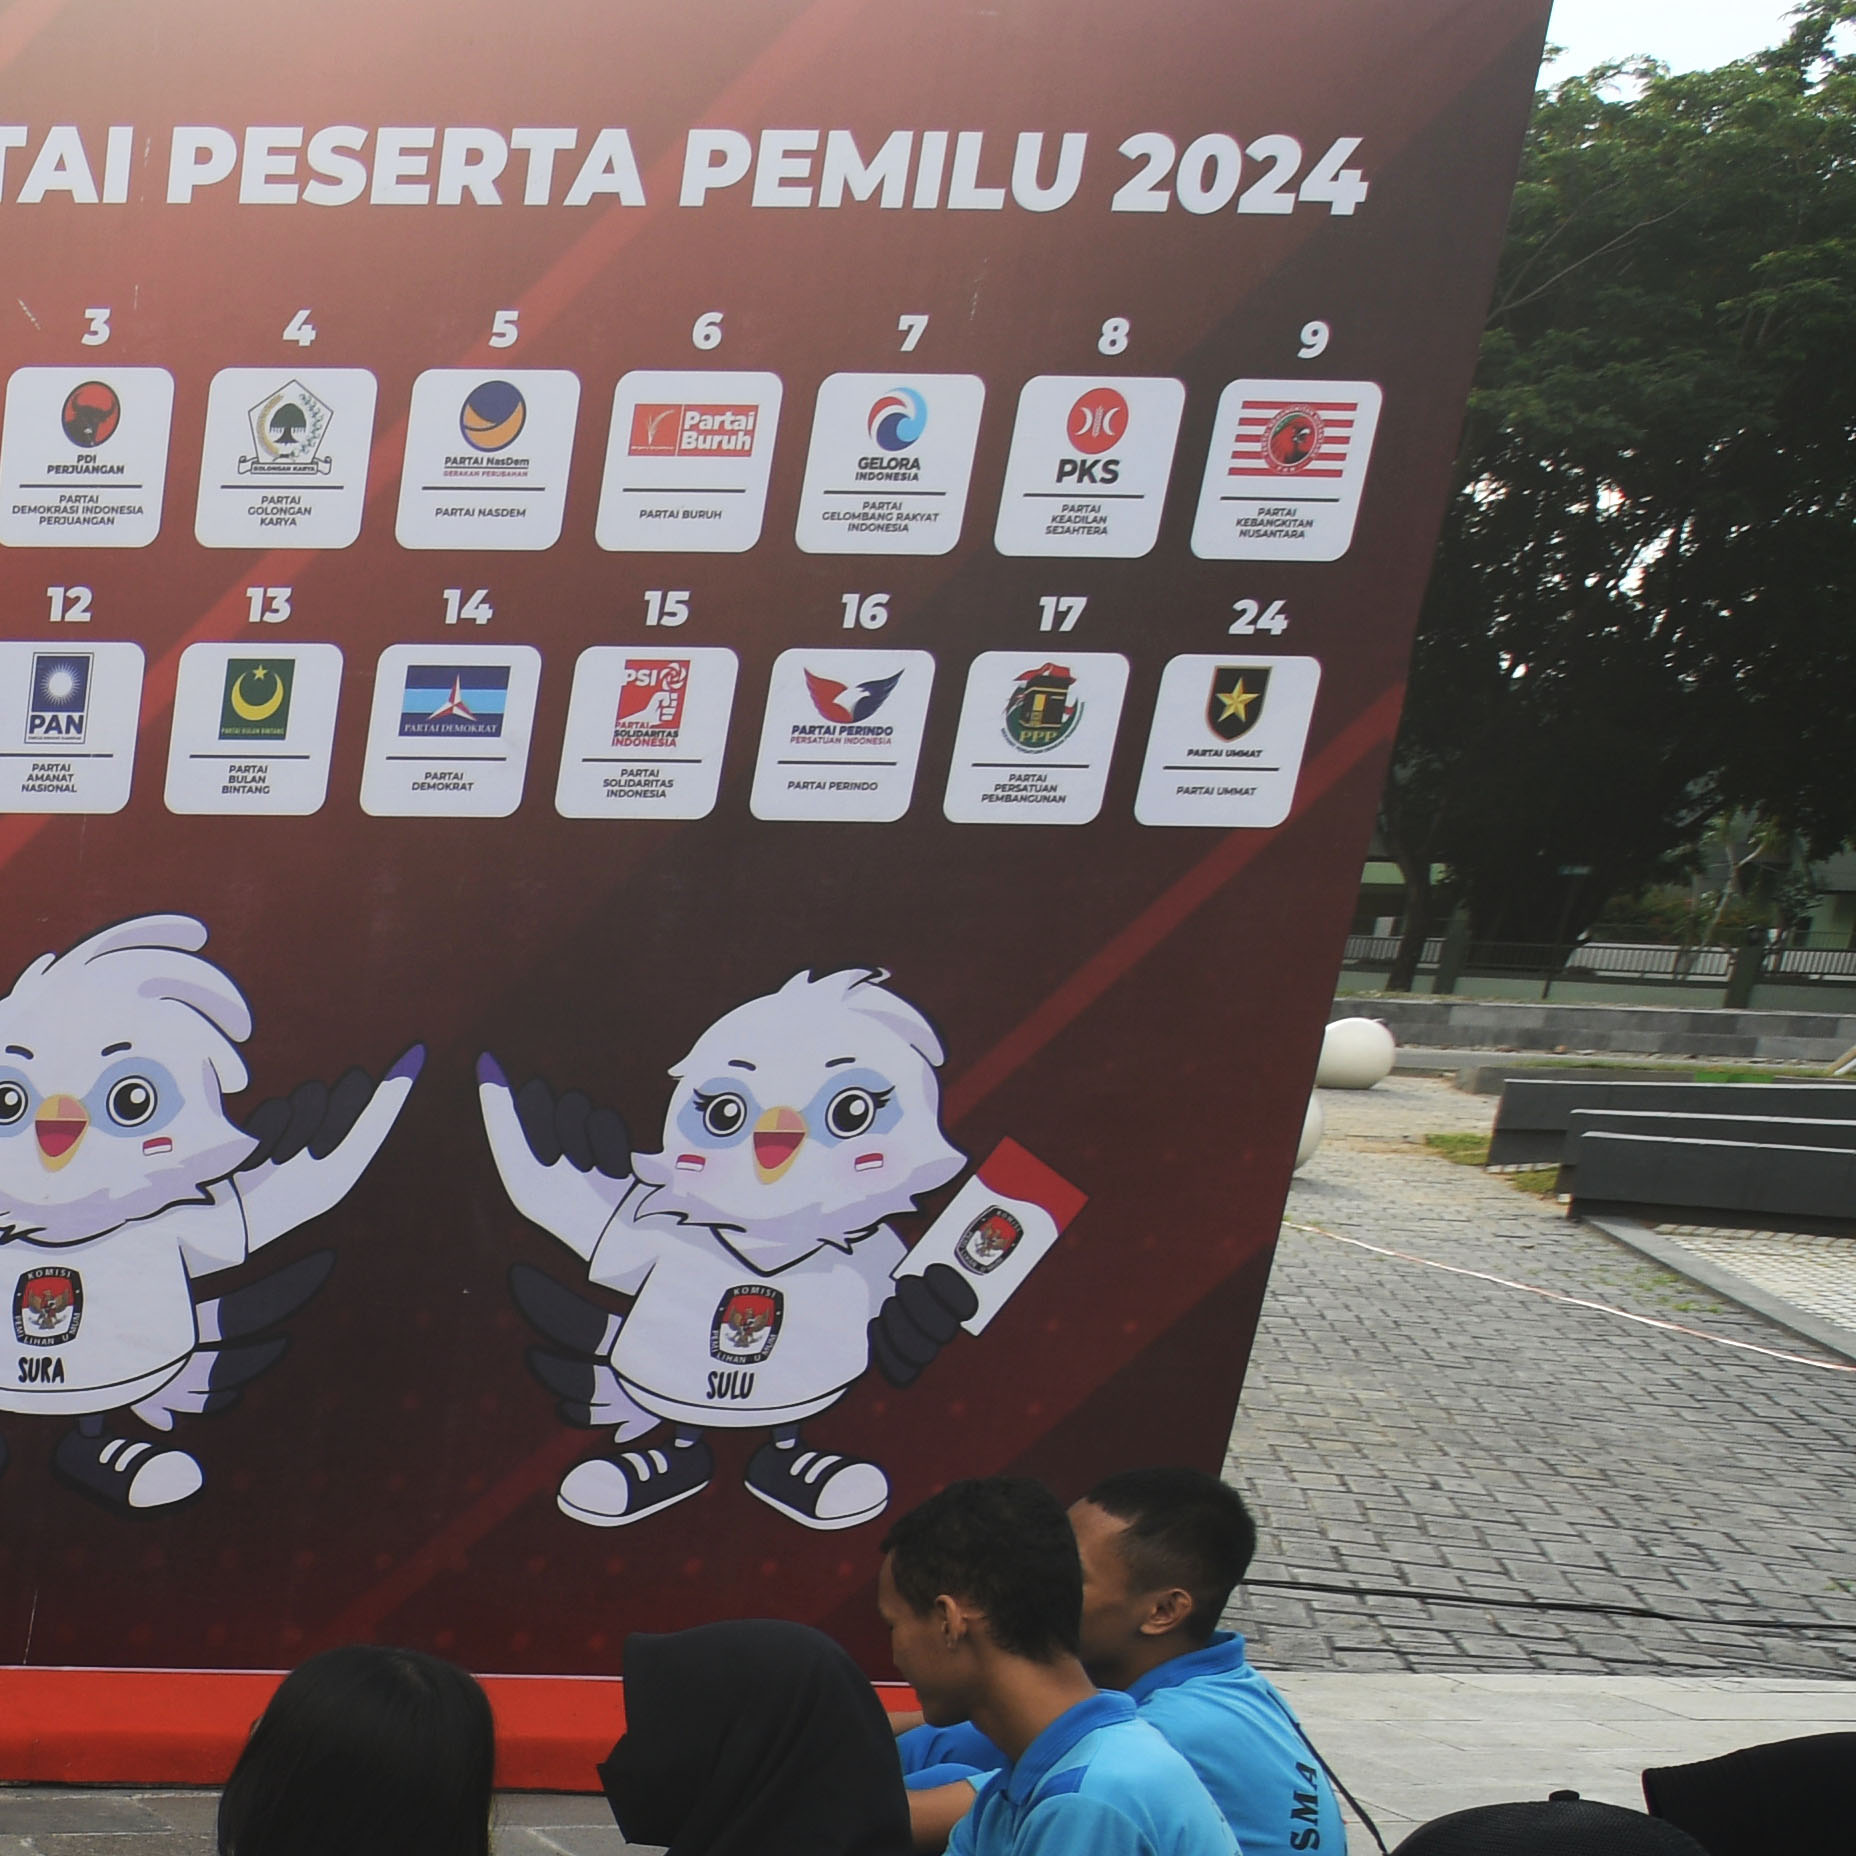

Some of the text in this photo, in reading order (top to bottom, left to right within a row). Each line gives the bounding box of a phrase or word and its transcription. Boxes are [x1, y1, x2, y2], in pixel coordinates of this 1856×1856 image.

[164, 126, 646, 208] PESERTA
[679, 130, 1086, 213] PEMILU
[1112, 134, 1369, 217] 2024
[81, 308, 111, 346] 3
[282, 309, 316, 347] 4
[488, 310, 519, 348] 5
[692, 312, 723, 350] 6
[897, 315, 929, 352] 7
[1097, 317, 1130, 356] 8
[1297, 320, 1329, 359] 9
[684, 411, 755, 430] Partai
[680, 431, 752, 451] Buruh
[77, 454, 97, 464] PDI
[486, 457, 529, 467] NasDem
[858, 457, 921, 470] GELORA
[855, 472, 919, 482] INDONESIA
[1056, 459, 1120, 484] PKS
[12, 505, 144, 515] DEMOKRASI INDONESIA
[248, 506, 312, 516] GOLONGAN
[435, 508, 526, 518] PARTAI NASDEM
[639, 509, 722, 520] PARTAI BURUH
[39, 516, 115, 525] PERJUANGAN
[260, 517, 297, 526] KARYA
[822, 512, 939, 522] GELOMBANG RAKYAT
[1050, 515, 1107, 524] KEADILAN
[1235, 517, 1314, 528] KEBANGKITAN
[847, 522, 909, 532] INDONESIA
[1045, 525, 1108, 535] SEJAHTERA
[1239, 529, 1305, 539] NUSANTARA
[47, 586, 92, 622] 12
[246, 587, 292, 623] 13
[443, 589, 493, 625] 14
[644, 591, 690, 627] 15
[841, 593, 890, 630] 16
[1038, 596, 1087, 632] 17
[1228, 599, 1288, 635] 24
[623, 669, 657, 687] PSI
[29, 714, 84, 735] PAN
[791, 725, 893, 736] PARTAI PERINDO
[1019, 730, 1057, 742] PPP
[26, 773, 74, 783] AMANAT
[228, 775, 266, 784] BULAN
[602, 778, 673, 788] SOLIDARITAS
[21, 784, 77, 793] NASIONAL
[221, 785, 270, 794] BINTANG
[411, 781, 474, 791] DEMOKRAT
[994, 784, 1057, 793] PERSATUAN
[1176, 786, 1256, 796] PARTAI UMMAT
[606, 789, 667, 798] INDONESIA
[981, 794, 1066, 804] PEMBANGUNAN
[18, 1357, 65, 1384] SURA
[706, 1370, 755, 1400] SULU
[1290, 1762, 1320, 1851] SMA
